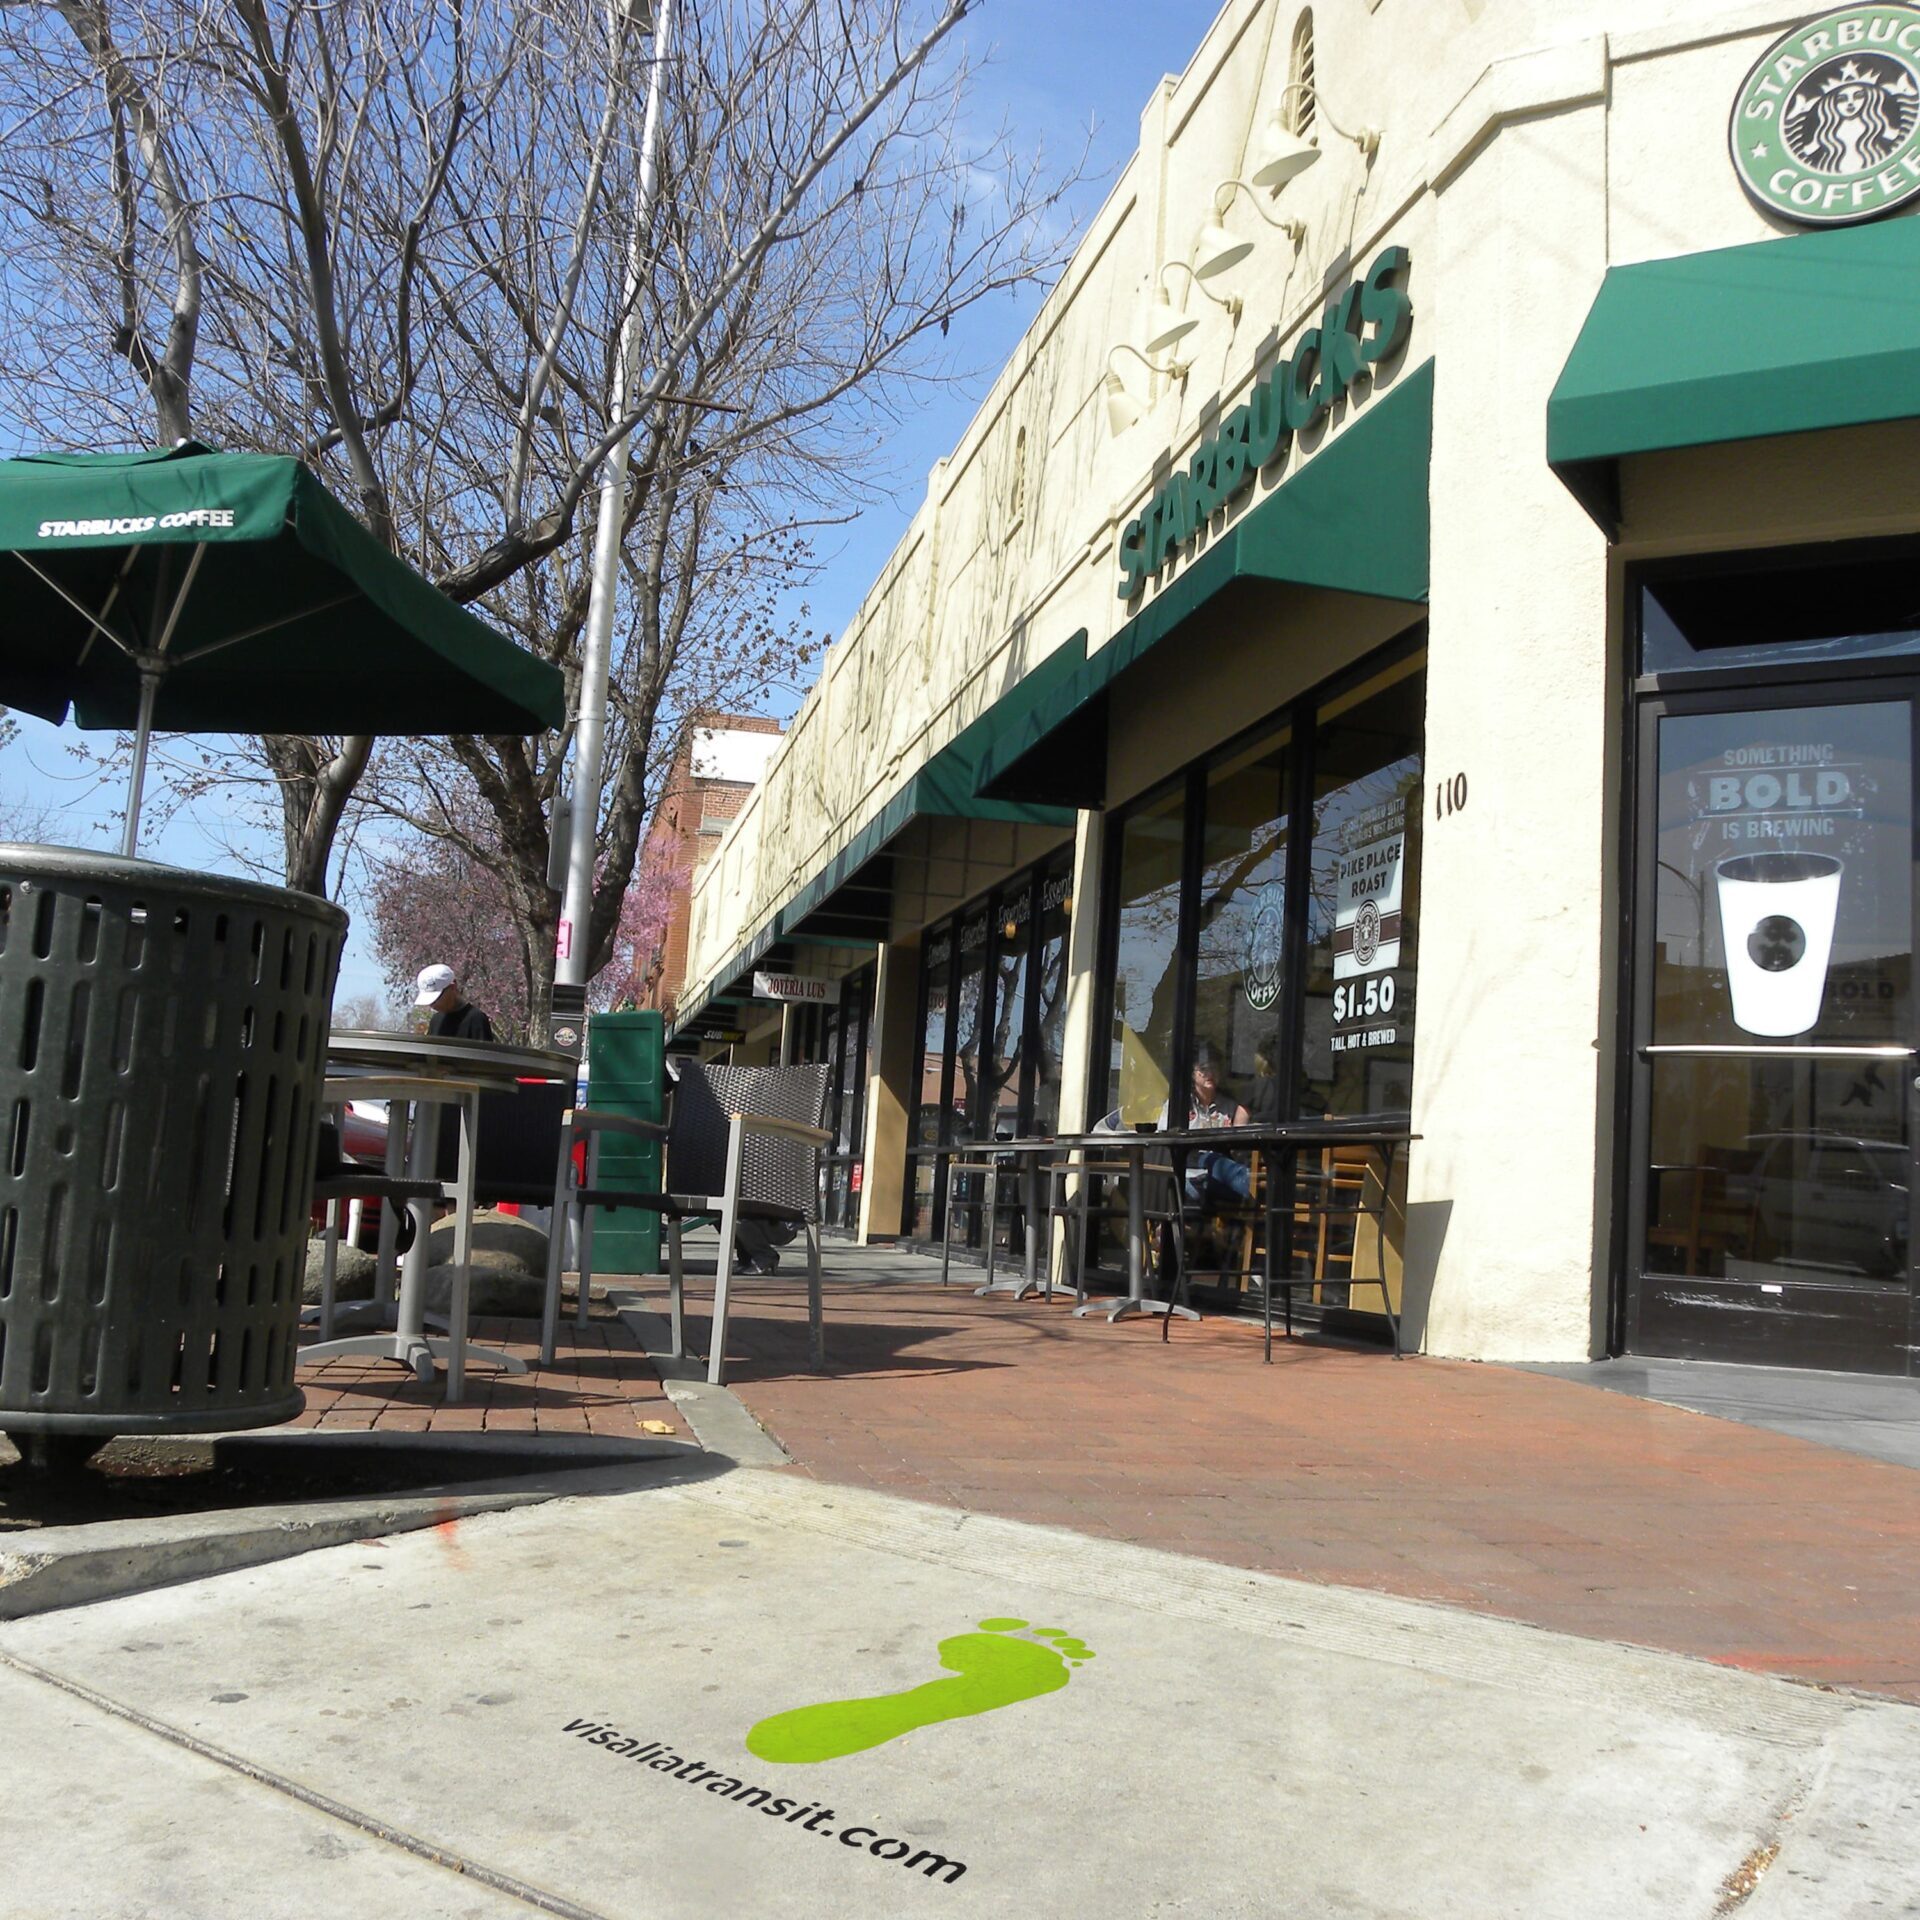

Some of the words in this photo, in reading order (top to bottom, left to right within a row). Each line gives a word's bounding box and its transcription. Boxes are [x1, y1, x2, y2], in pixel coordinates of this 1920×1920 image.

[1769, 145, 1920, 209] COFFEE
[1117, 245, 1412, 600] STARBUCKS
[38, 516, 157, 537] STARBUCKS
[158, 509, 235, 529] COFFEE
[1724, 743, 1834, 766] SOMETHING
[1436, 771, 1468, 821] 110
[1709, 771, 1851, 811] BOLD
[1722, 821, 1740, 840] IS
[1746, 818, 1835, 840] BREWING
[1340, 856, 1364, 880] PIKE
[1366, 843, 1402, 871] PLACE
[1351, 871, 1387, 898] ROAST
[806, 982, 826, 999] LUIS
[1247, 969, 1281, 1003] COFFEE
[1333, 975, 1395, 1024] $1.50
[1347, 1033, 1361, 1049] HOT
[1361, 1032, 1367, 1047] &
[1368, 1028, 1396, 1047] BREWED
[561, 1718, 968, 1884] visaliatransit.com
